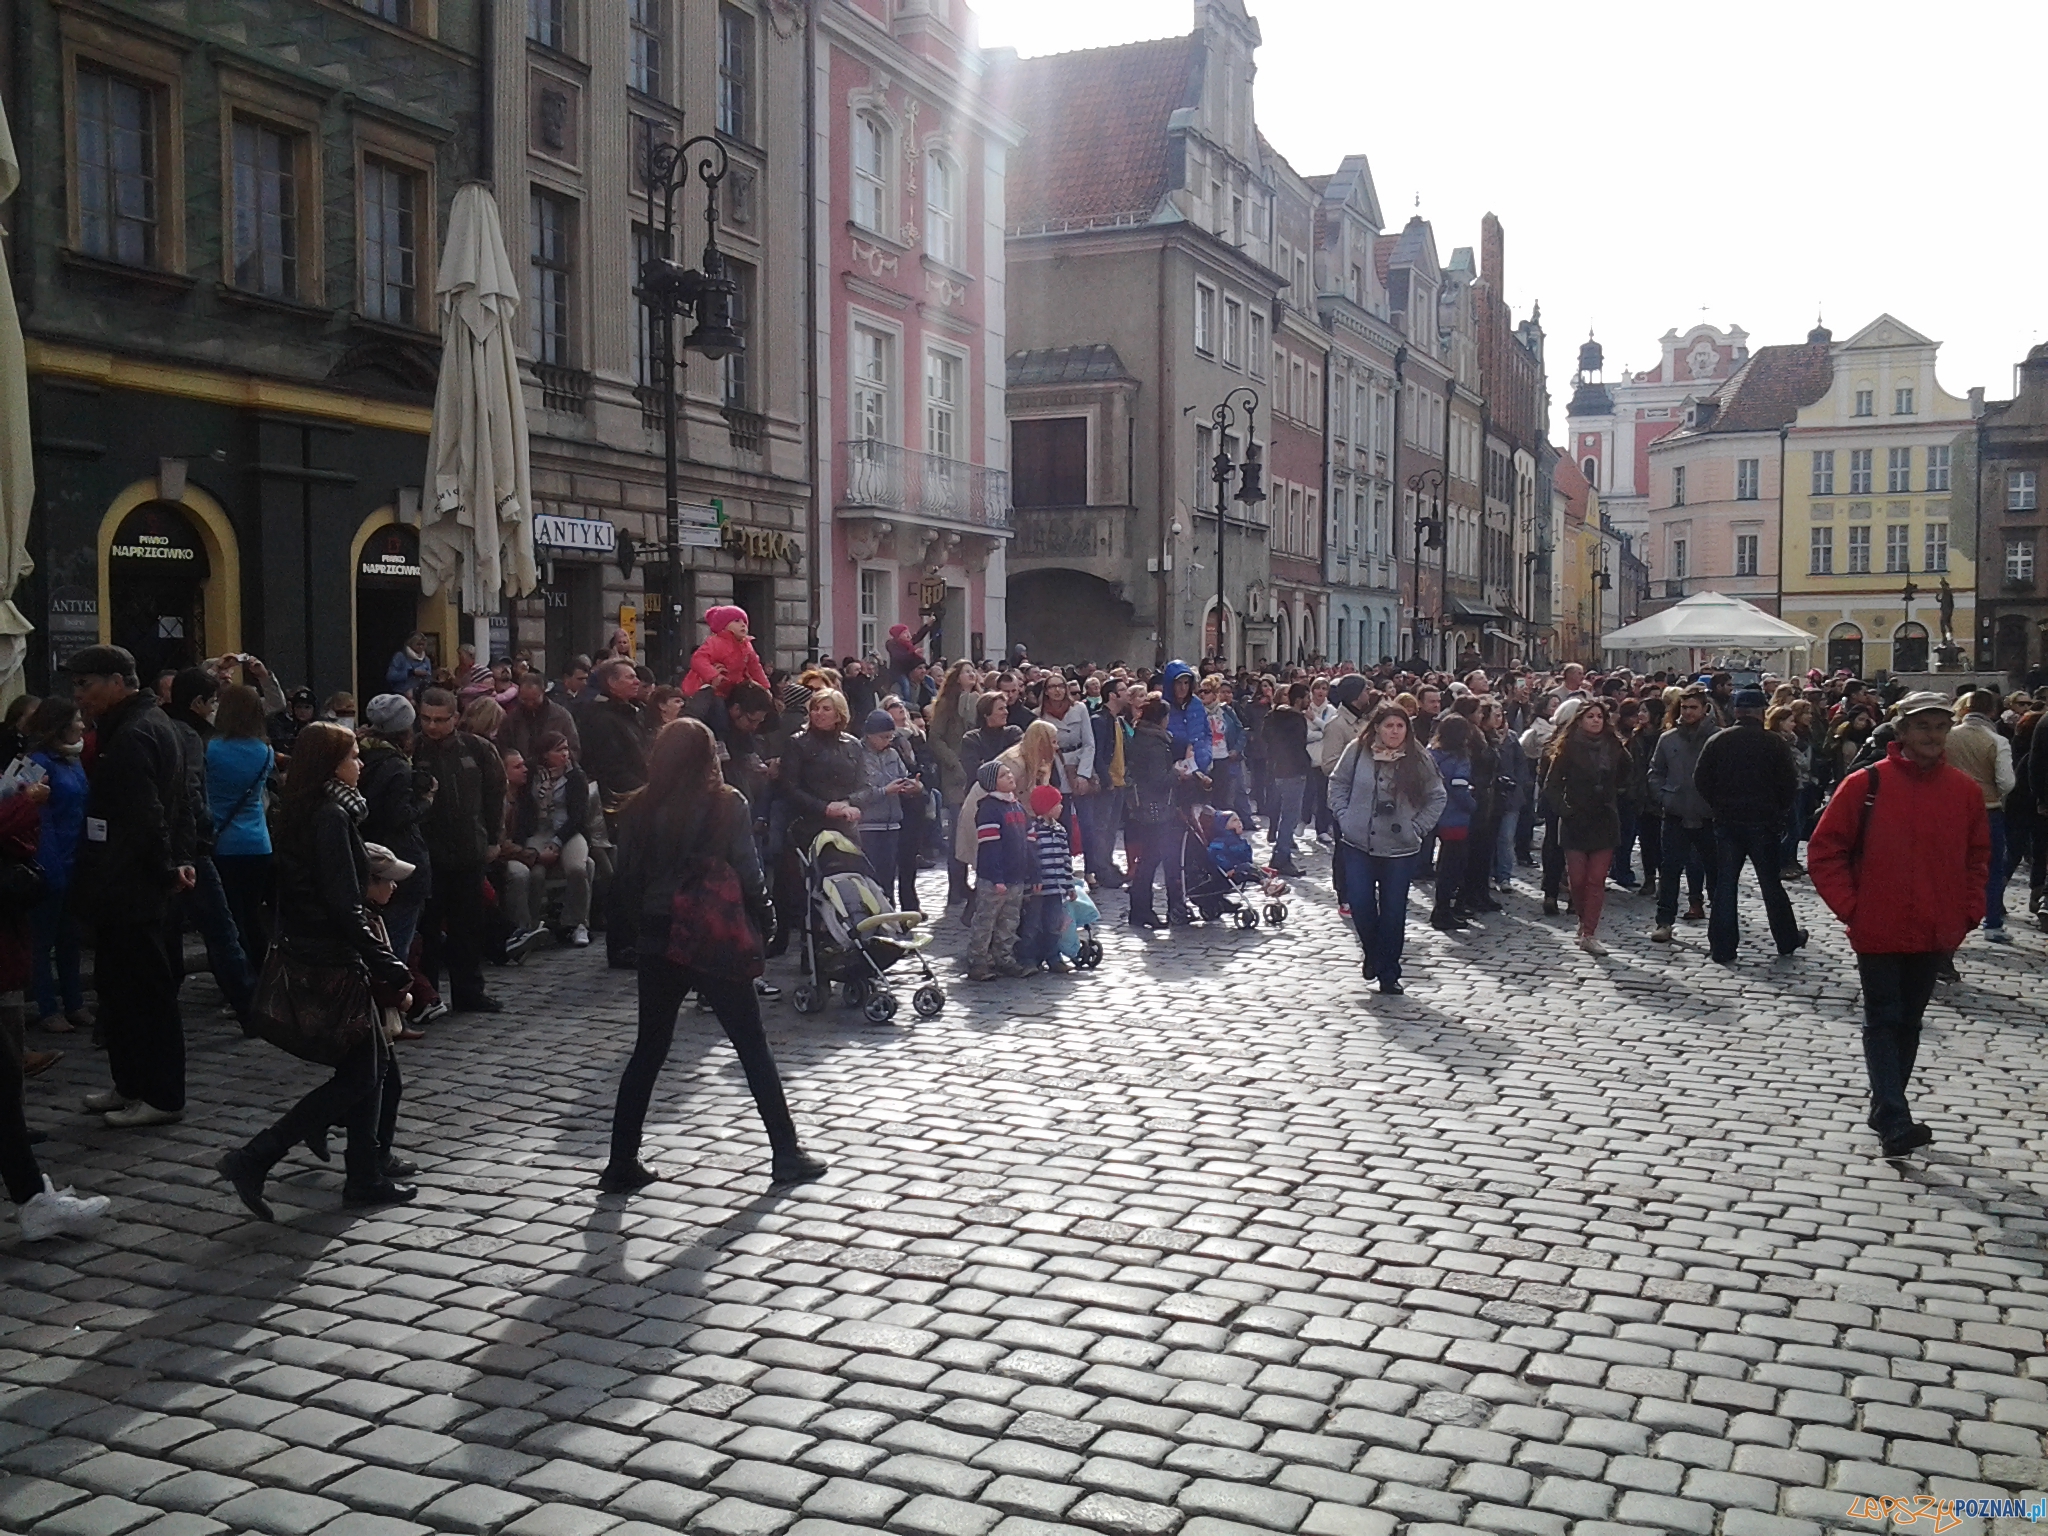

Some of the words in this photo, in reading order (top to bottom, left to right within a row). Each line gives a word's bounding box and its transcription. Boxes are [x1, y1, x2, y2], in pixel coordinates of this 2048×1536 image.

[139, 535, 169, 545] PIWKO
[539, 519, 613, 547] ANTYKI
[112, 545, 194, 560] NAPRZECIWKO
[51, 600, 97, 613] ANTYKI
[546, 592, 567, 607] YKI
